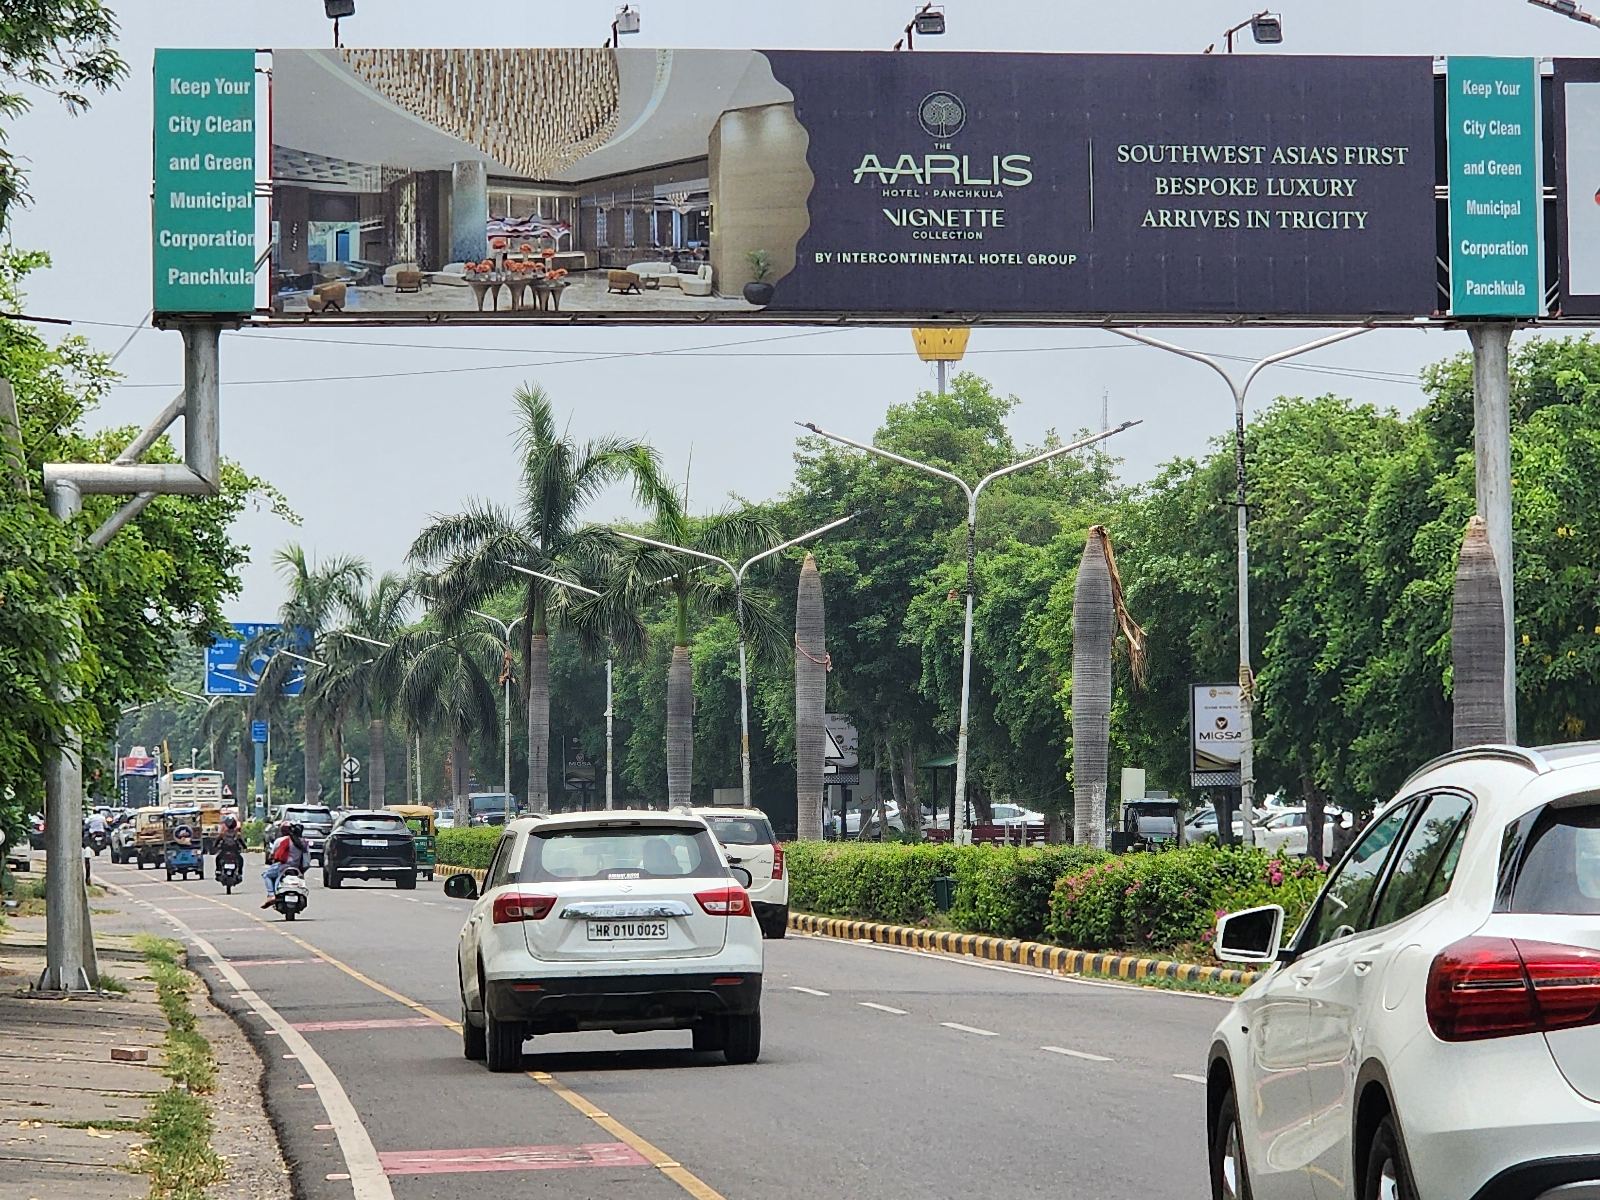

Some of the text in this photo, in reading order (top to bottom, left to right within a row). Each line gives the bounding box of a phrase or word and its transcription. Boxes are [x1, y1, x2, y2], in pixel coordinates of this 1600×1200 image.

[170, 78, 251, 98] Keep Your
[1462, 79, 1521, 98] Keep Your
[168, 115, 253, 136] City Clean
[1463, 120, 1521, 139] City Clean
[169, 153, 253, 170] and Green
[1117, 145, 1409, 166] SOUTHWEST ASIA'S FIRST
[853, 154, 1033, 186] AARLIS
[1463, 160, 1522, 176] and Green
[882, 189, 1004, 198] HOTEL PANCHKULA
[1155, 177, 1358, 197] BESPOKE LUXURY
[170, 192, 252, 212] Municipal
[1466, 199, 1521, 219] Municipal
[882, 208, 1005, 228] VIGNETTE
[1141, 209, 1369, 229] ARRIVES IN TRICITY
[160, 229, 255, 250] Corporation
[912, 230, 983, 240] COLLECTION
[815, 252, 1077, 265] BY INTERCONTINENTAL HOTEL GROUP
[1461, 239, 1528, 259] Corporation
[168, 268, 255, 285] Panchkula
[1466, 280, 1526, 296] Panchkula
[209, 662, 216, 671] 5
[596, 924, 666, 937] HR 01U 0025
